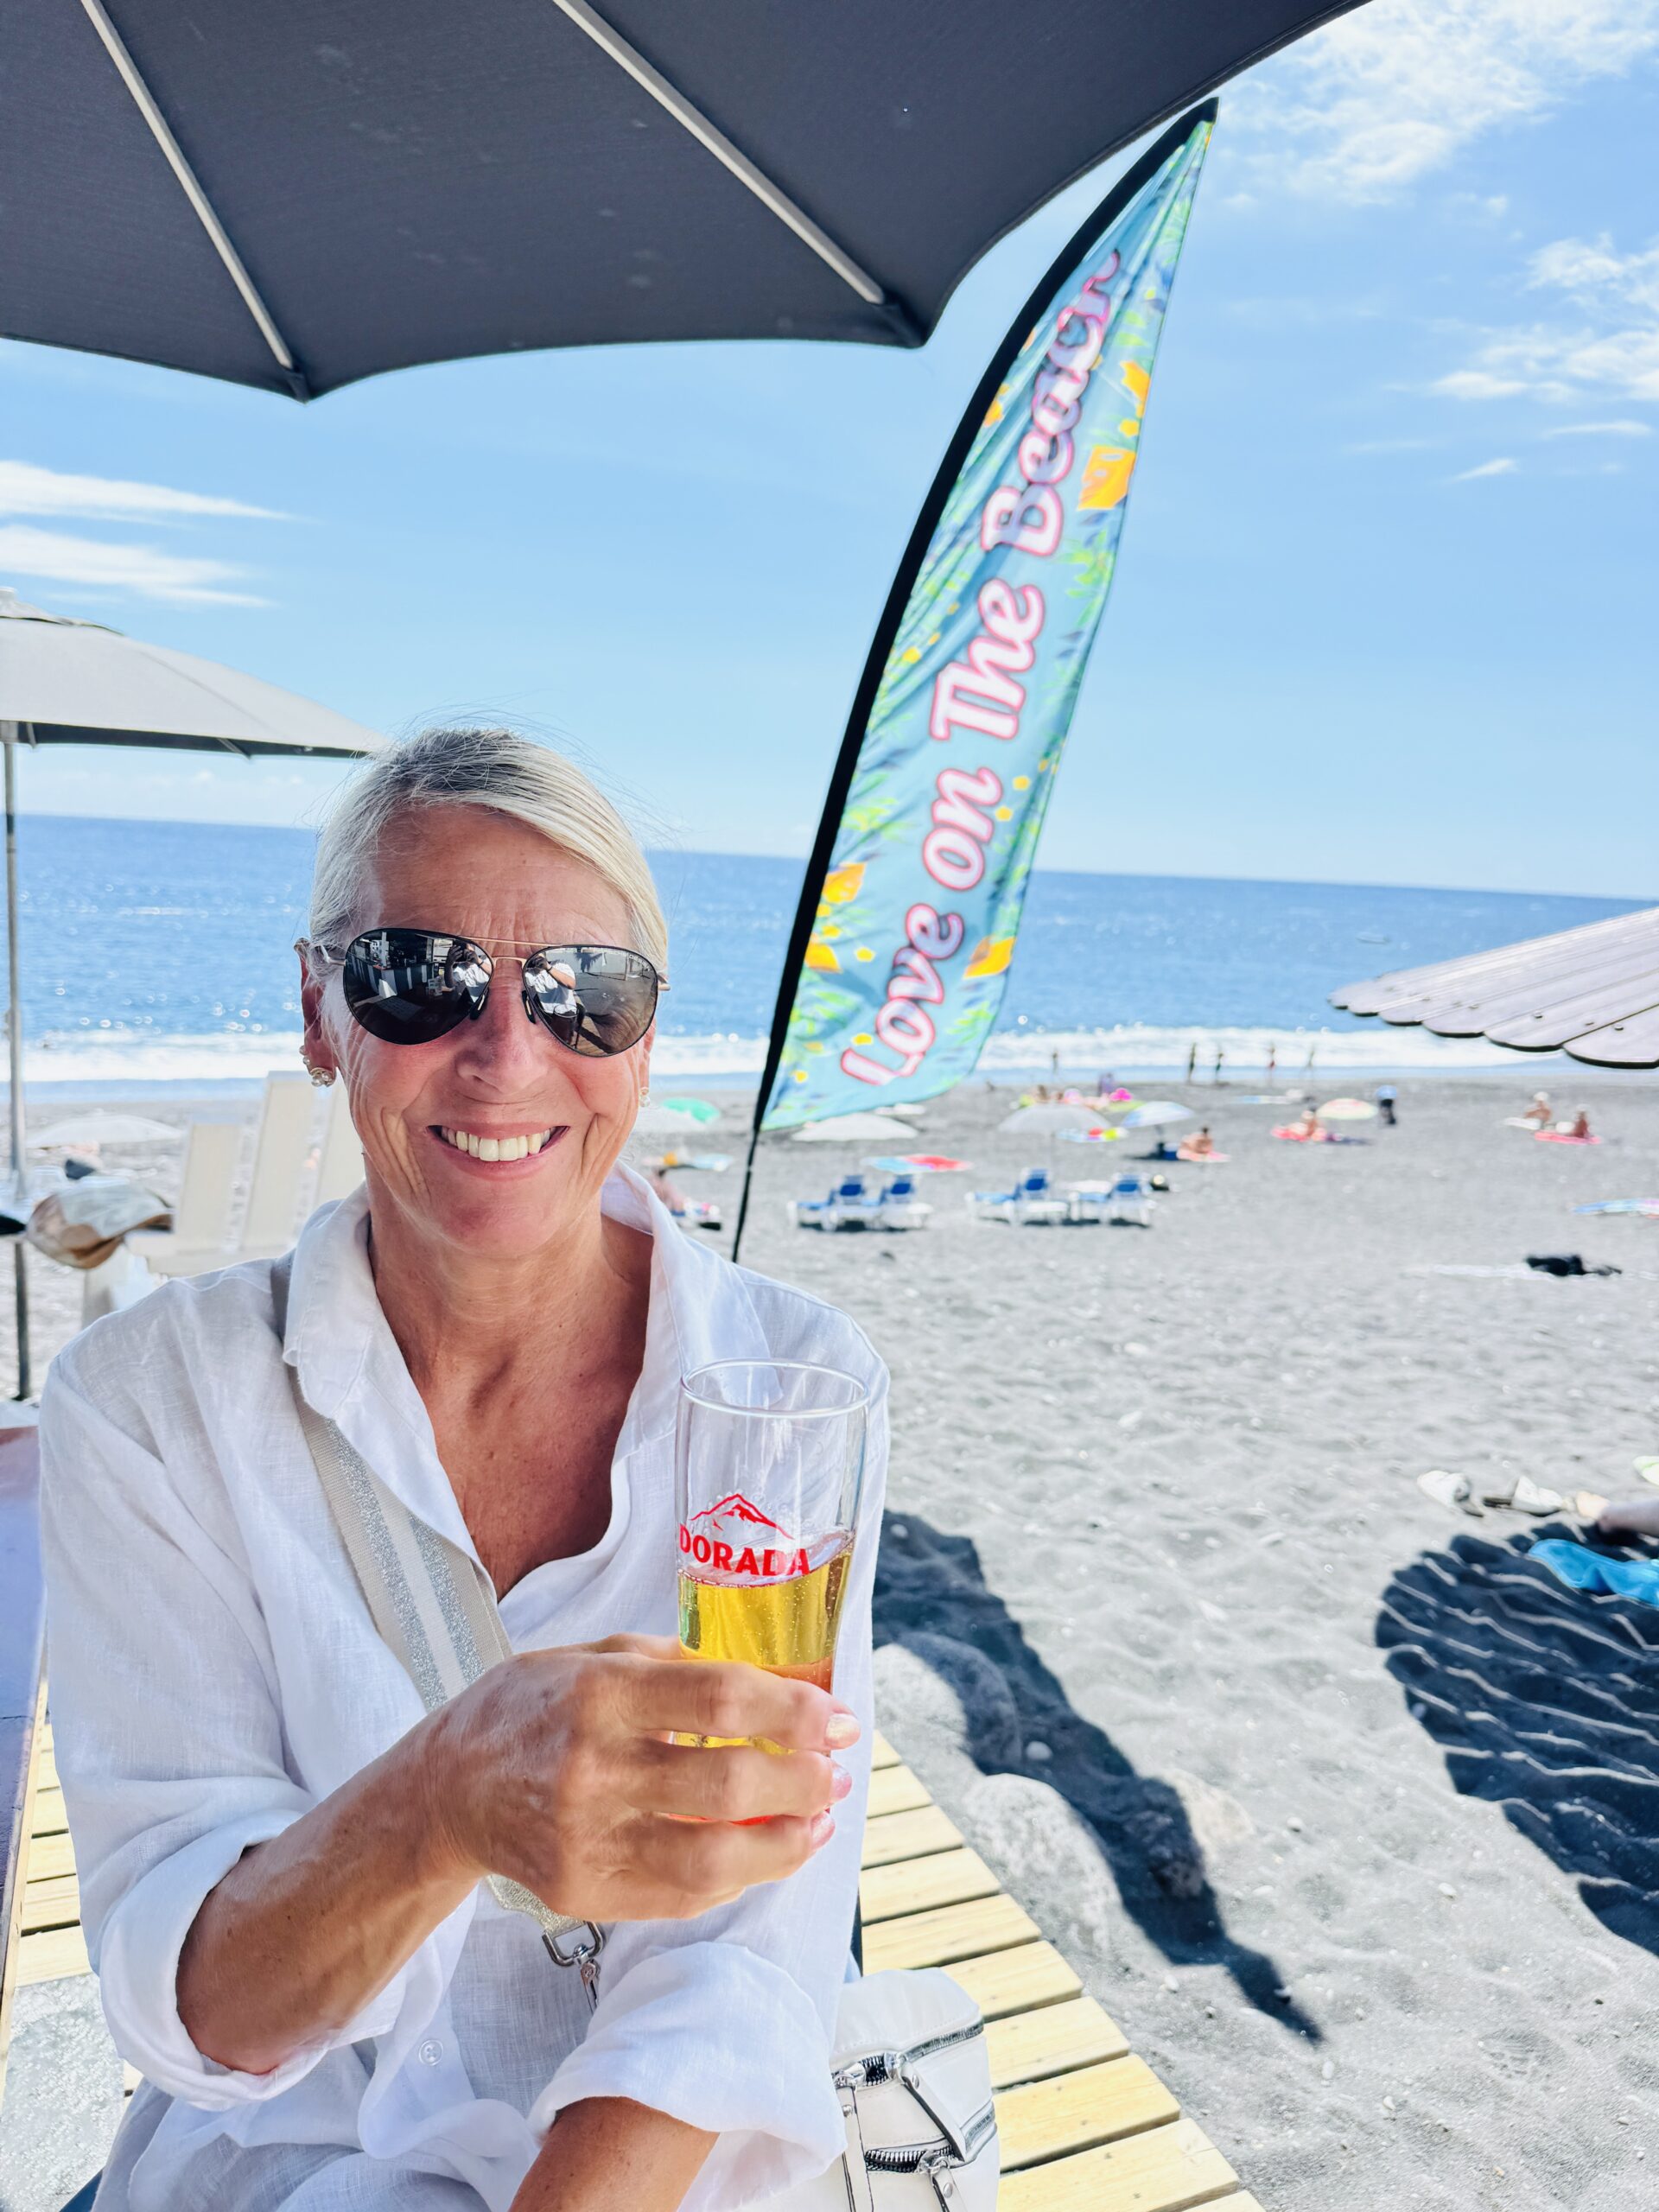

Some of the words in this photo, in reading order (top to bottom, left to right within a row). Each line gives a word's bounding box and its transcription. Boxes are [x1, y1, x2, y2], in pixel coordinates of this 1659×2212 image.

[929, 576, 1046, 741] The
[922, 766, 1003, 891] on
[840, 903, 965, 1086] Love
[679, 1523, 810, 1576] DORADA
